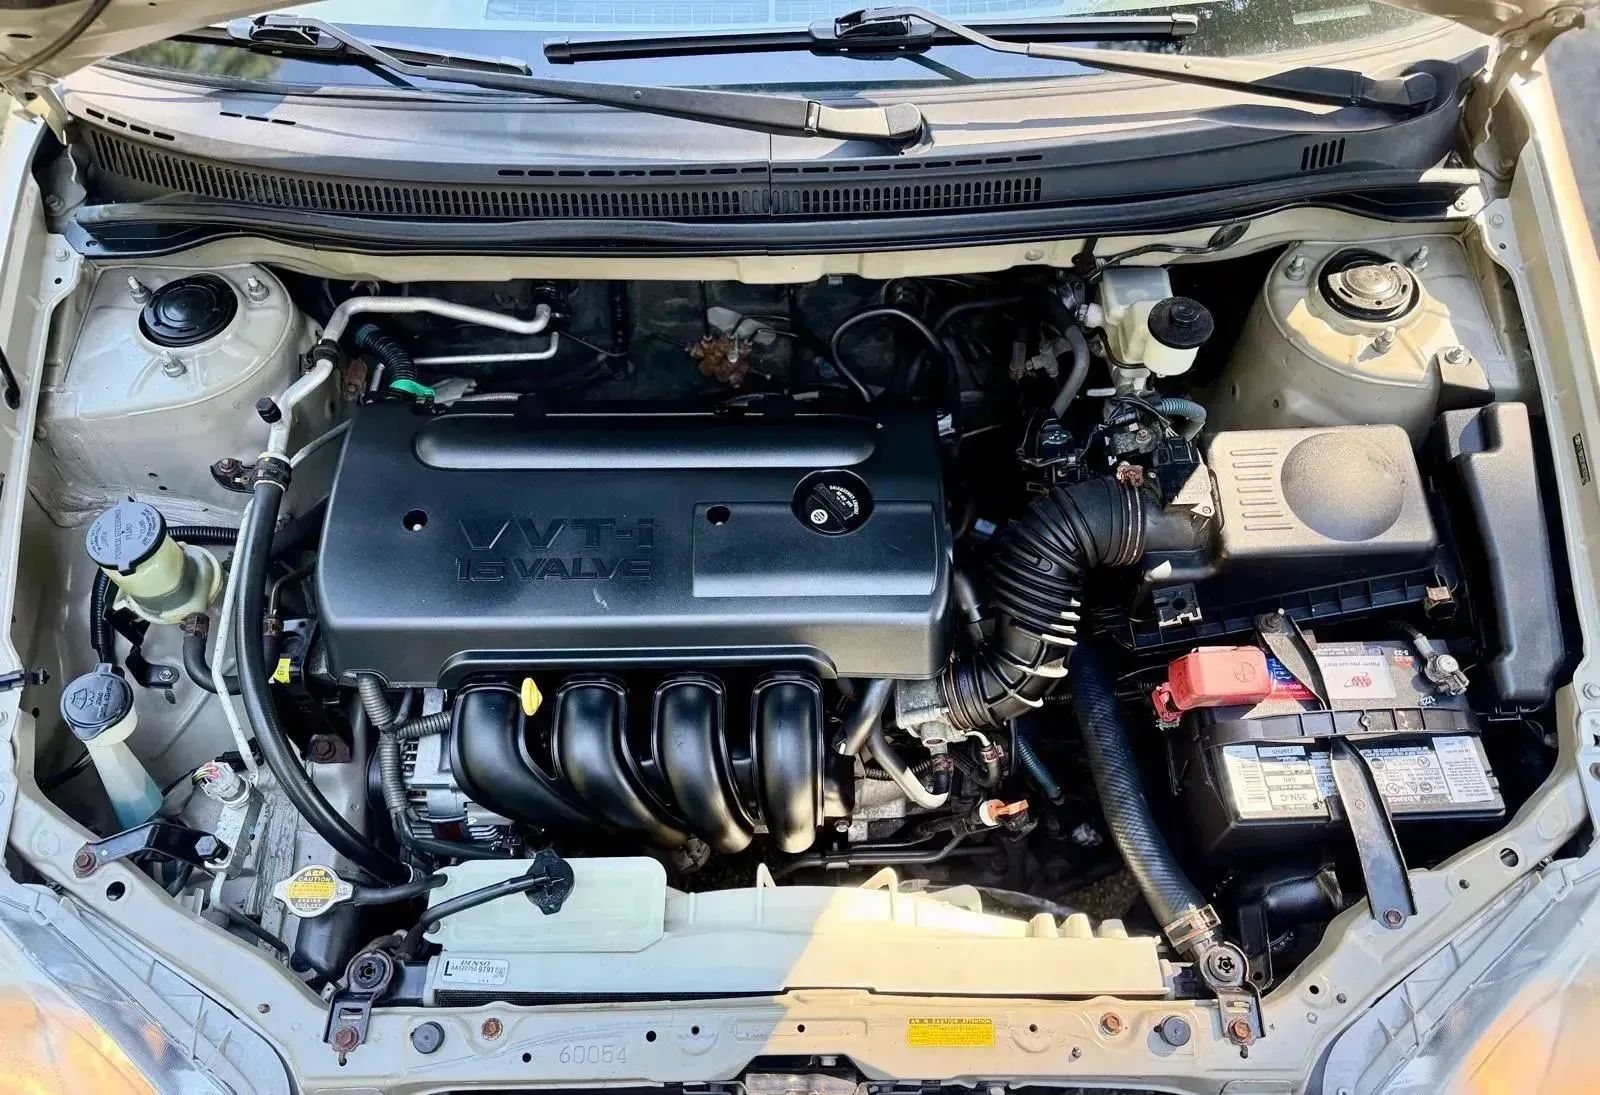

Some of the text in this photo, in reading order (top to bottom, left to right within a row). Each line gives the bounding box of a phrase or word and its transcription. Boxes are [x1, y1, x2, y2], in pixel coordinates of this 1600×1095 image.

[511, 557, 652, 582] VALVE
[443, 960, 453, 976] L
[559, 1044, 628, 1064] 60054
